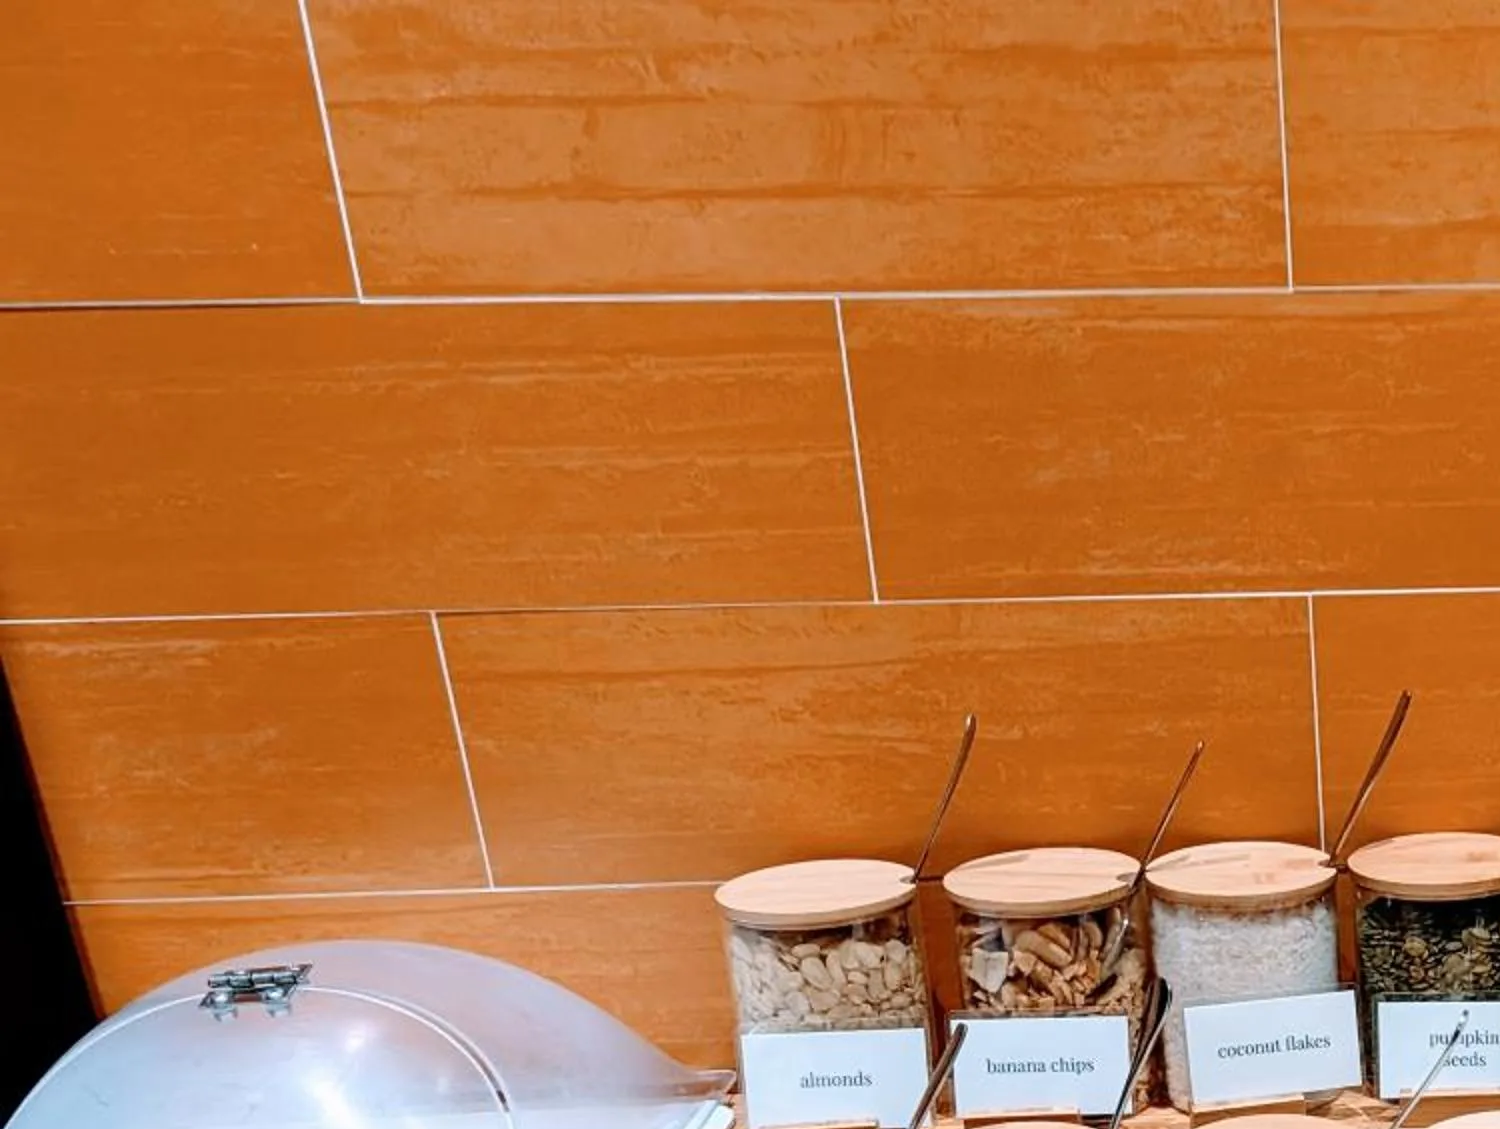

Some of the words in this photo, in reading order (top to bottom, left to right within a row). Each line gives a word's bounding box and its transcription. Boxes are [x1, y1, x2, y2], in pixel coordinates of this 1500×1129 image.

[1217, 1040, 1281, 1058] coconut
[1285, 1034, 1331, 1053] flakes
[986, 1058, 1047, 1074] banana
[1050, 1057, 1095, 1076] chips
[1442, 1051, 1487, 1067] seeds
[800, 1071, 873, 1089] almonds
